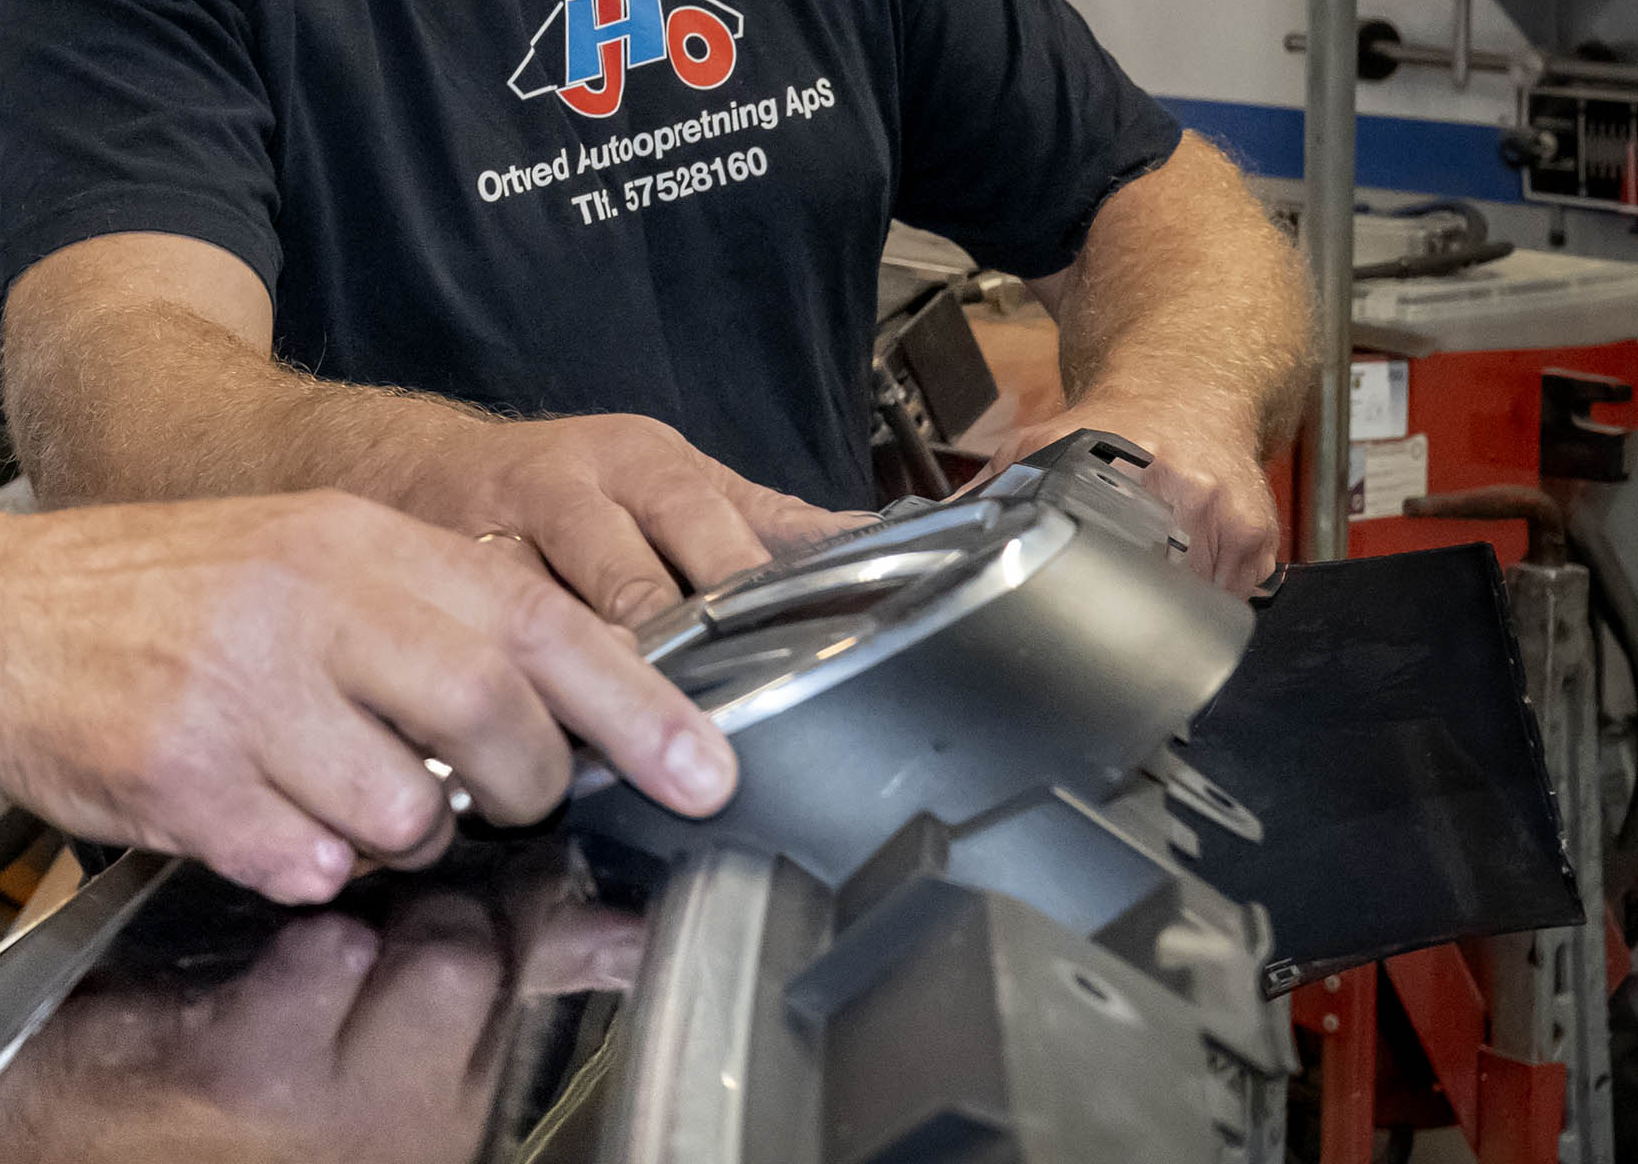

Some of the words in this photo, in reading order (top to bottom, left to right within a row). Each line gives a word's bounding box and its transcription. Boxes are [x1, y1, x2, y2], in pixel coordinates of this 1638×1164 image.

[477, 148, 570, 203] Ortved
[577, 100, 778, 174] Autoopretning
[785, 78, 835, 121] ApS
[572, 189, 618, 225] Tlf.
[624, 147, 768, 212] 57528160
